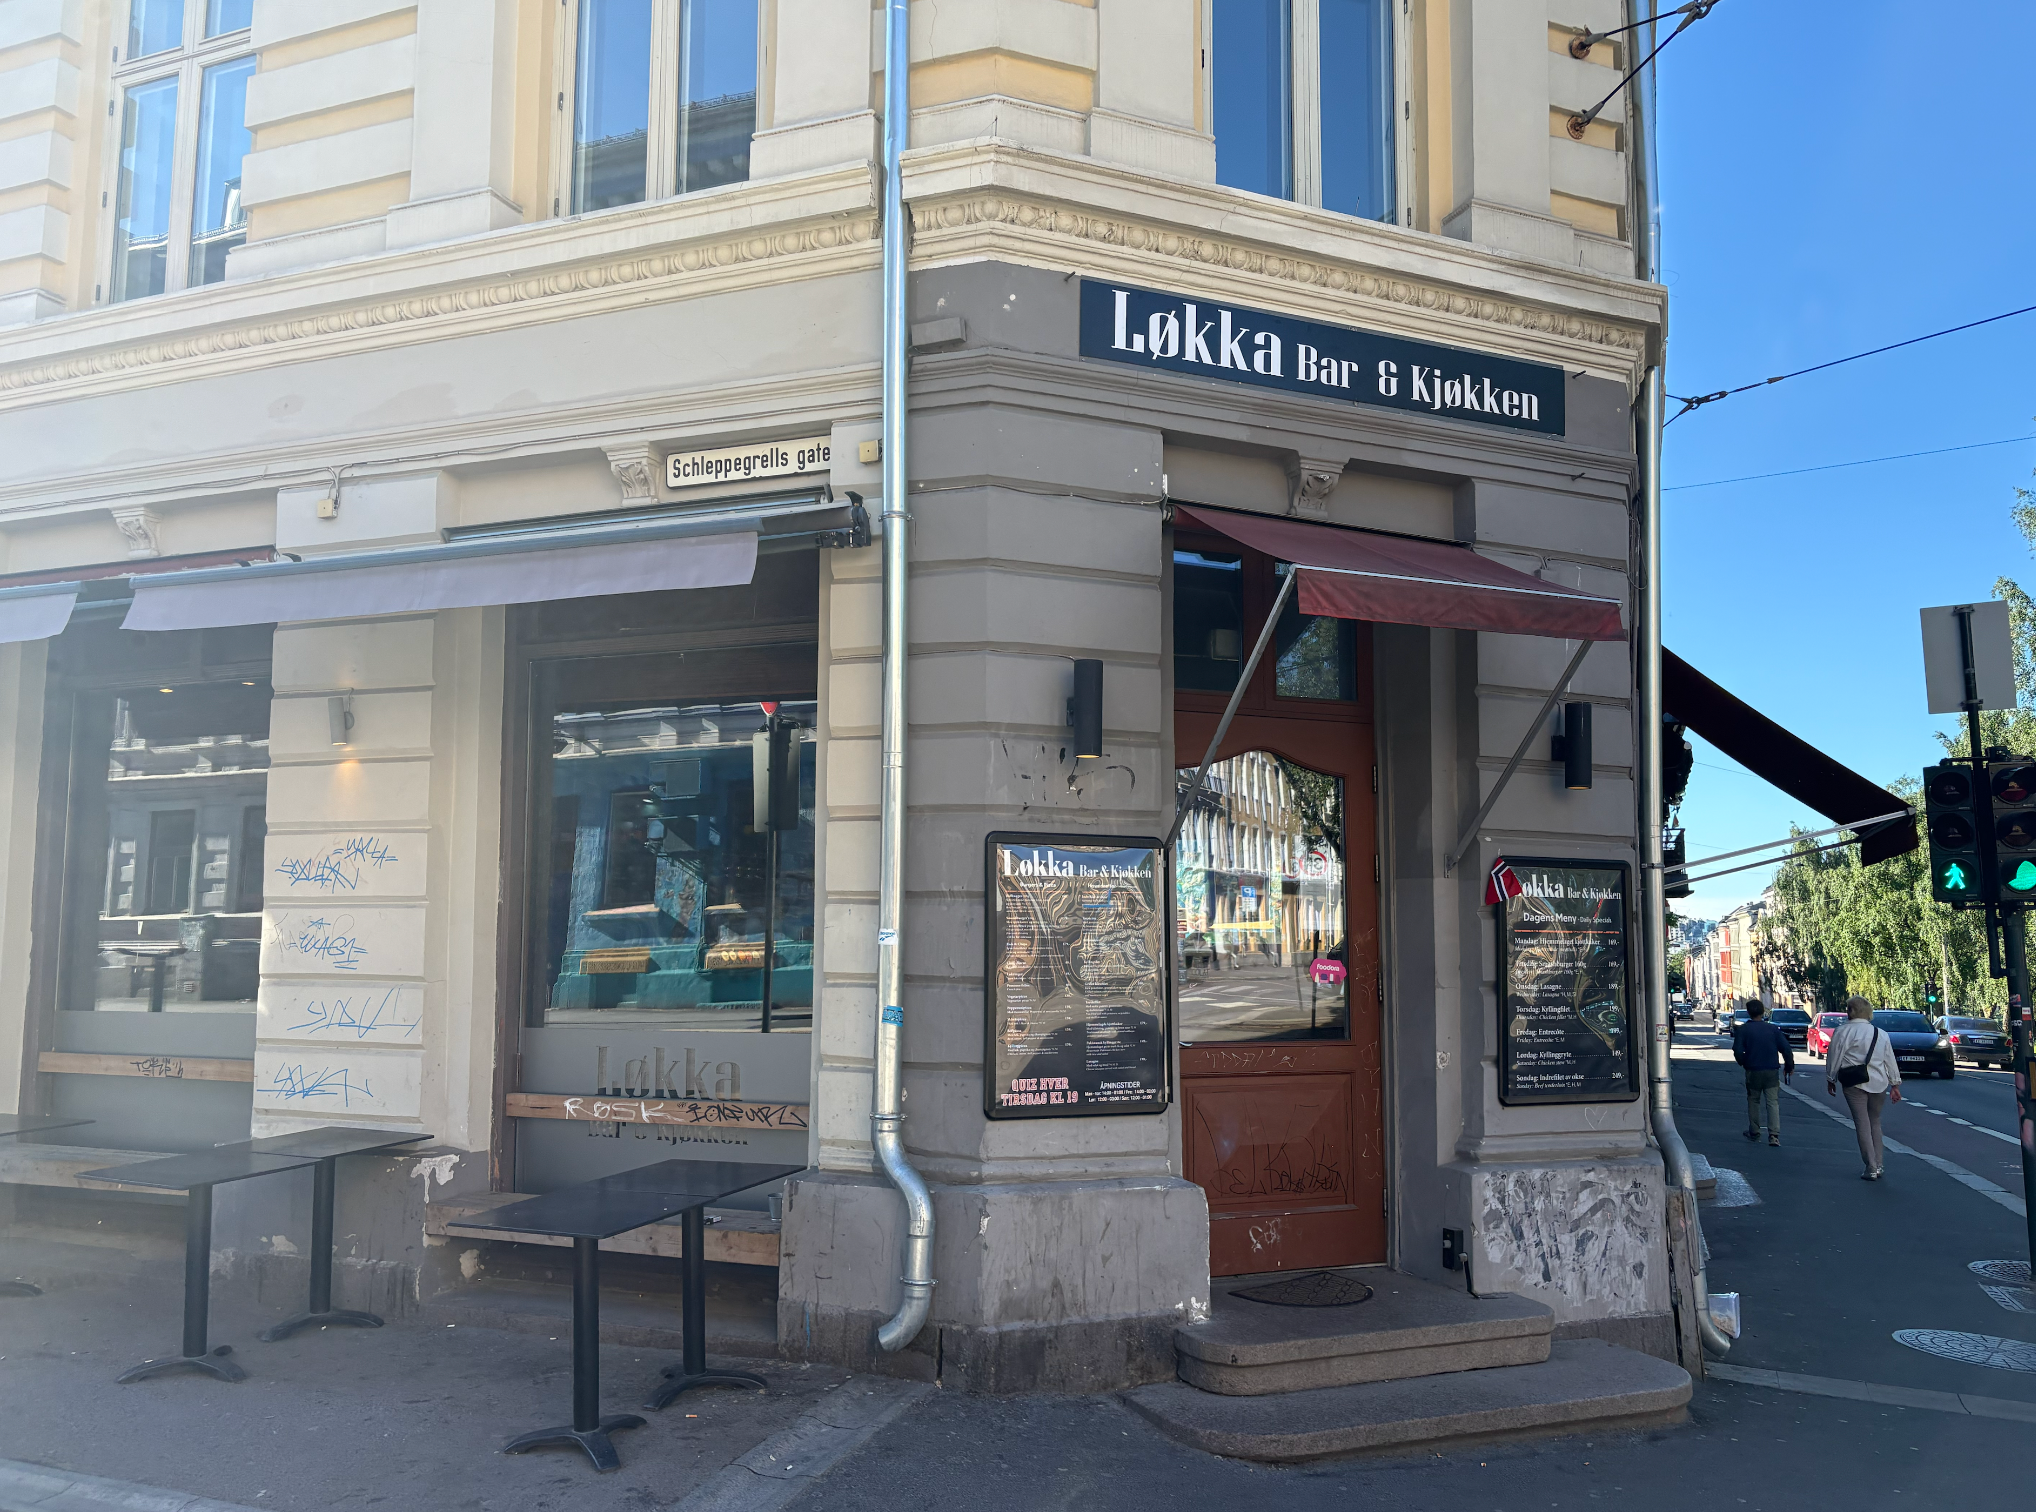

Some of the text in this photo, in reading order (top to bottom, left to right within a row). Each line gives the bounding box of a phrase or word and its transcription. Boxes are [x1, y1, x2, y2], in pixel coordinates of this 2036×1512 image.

[1111, 289, 1540, 422] Løkka Bar & Kjøkken
[673, 443, 831, 479] Schleppegrells gate
[1002, 849, 1152, 881] Løkka Bar & Kjøkken
[1516, 874, 1621, 902] økka Bar & Kjøkken
[1523, 912, 1554, 924] Dagens
[1555, 913, 1577, 925] Meny
[1316, 963, 1340, 972] foodora
[1540, 984, 1562, 992] Lasagne
[1516, 1006, 1539, 1014] Torsdag:
[1516, 1028, 1538, 1037] Fredag:
[595, 1045, 743, 1101] Løkka
[1516, 1074, 1538, 1083] Søndag:
[1012, 1077, 1069, 1092] QUIZ HVER
[1100, 1080, 1141, 1090] ÅPNINGSTIDER
[1001, 1090, 1079, 1106] TIRSDAG KL 19
